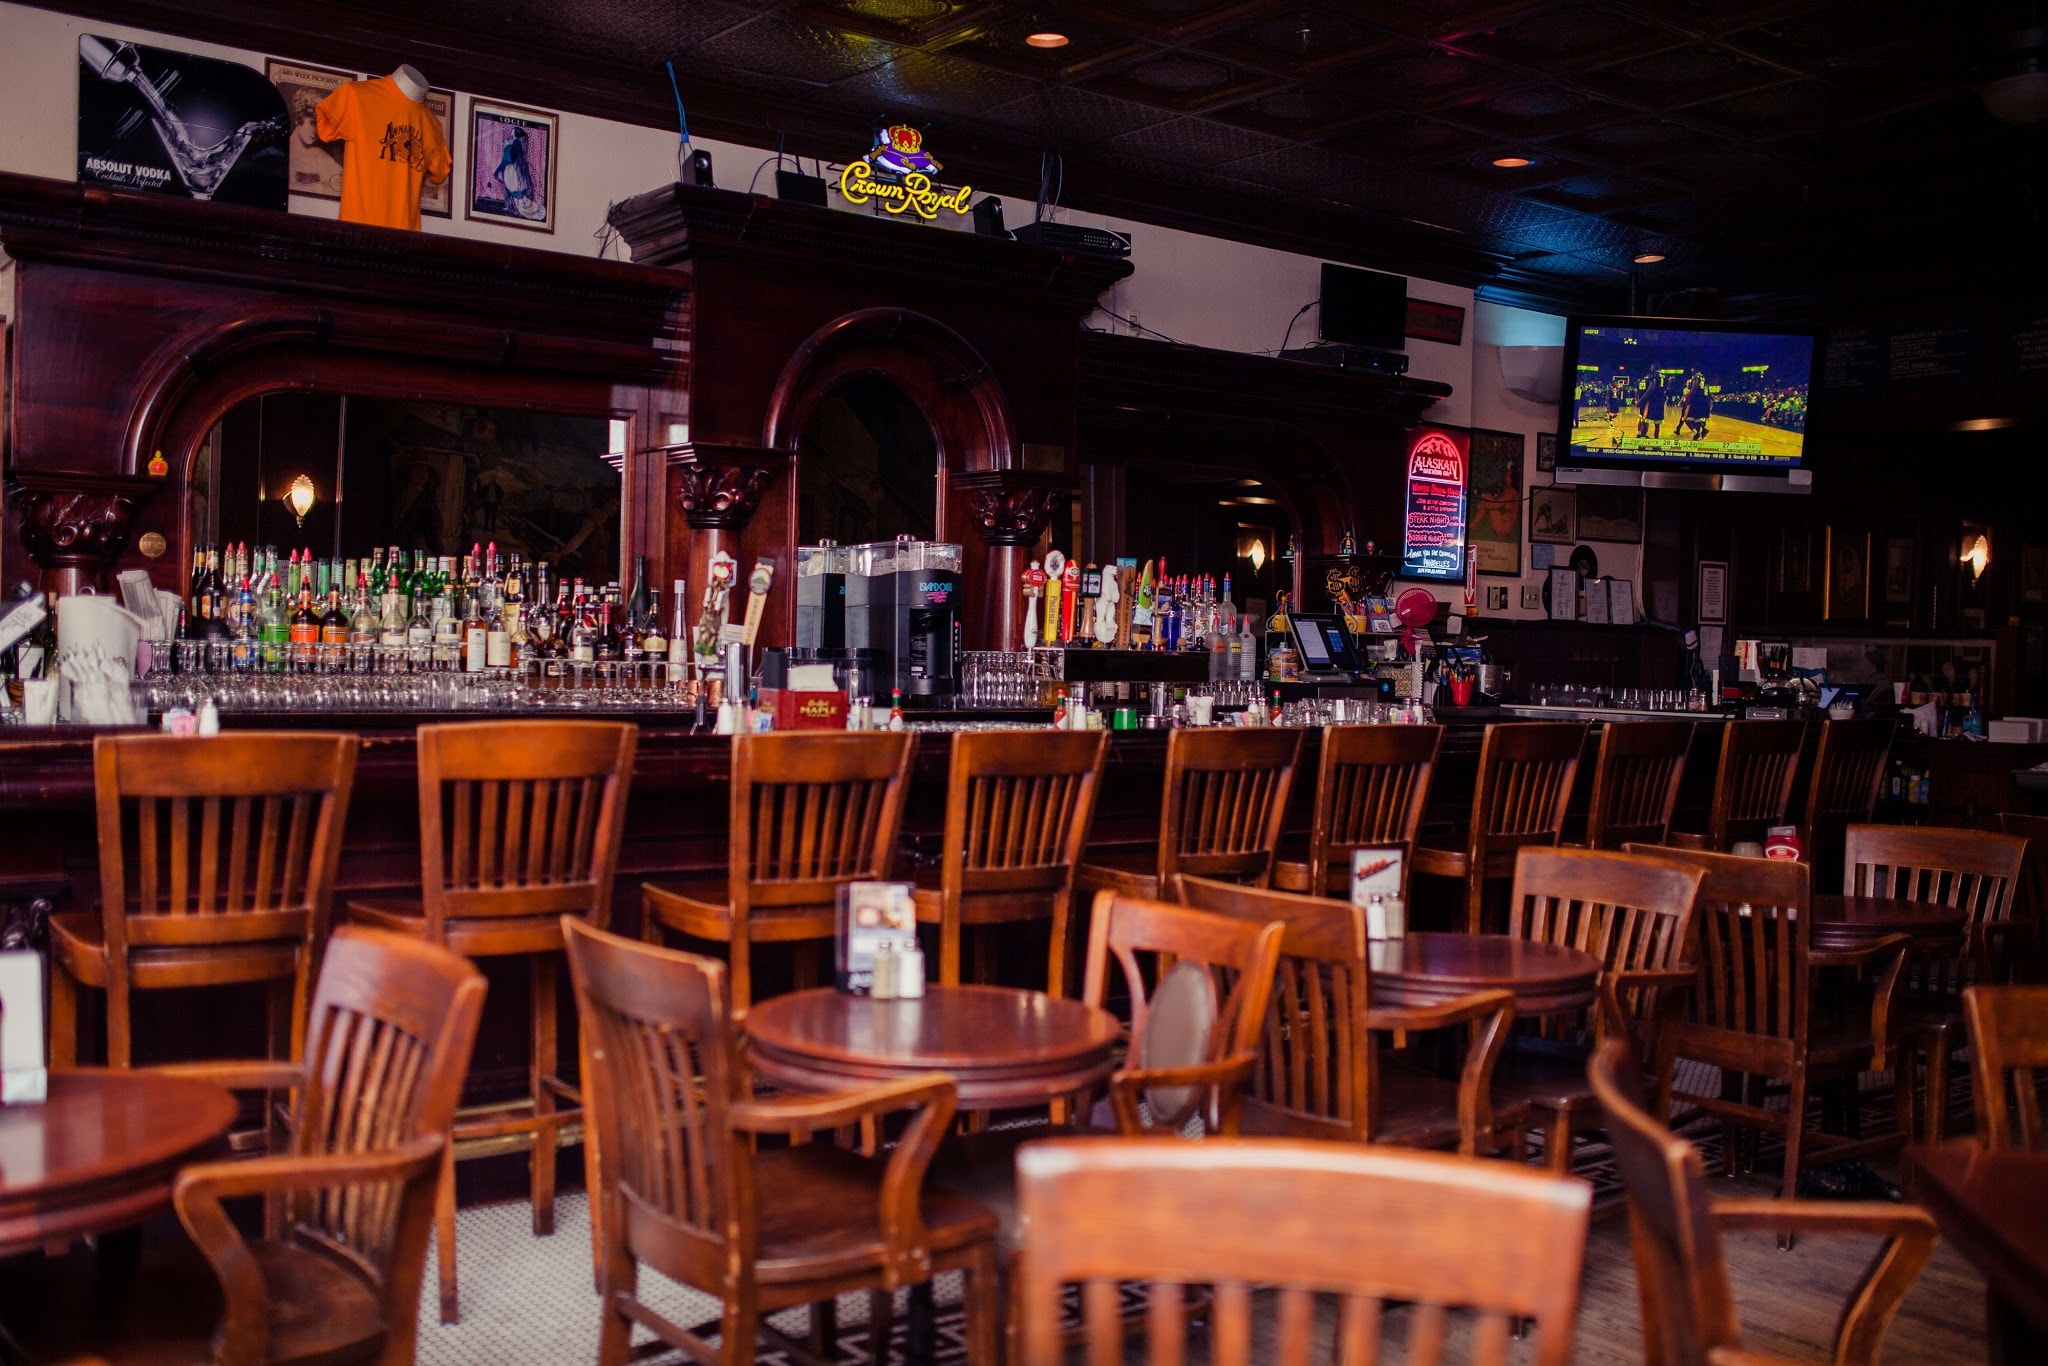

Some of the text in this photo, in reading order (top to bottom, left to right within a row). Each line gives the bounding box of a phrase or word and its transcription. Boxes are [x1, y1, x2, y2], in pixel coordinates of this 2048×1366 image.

[499, 117, 526, 127] VOGUE
[86, 158, 171, 181] ABSOLUT VODKA
[841, 161, 972, 220] Crown Royal
[1412, 456, 1459, 480] ALASKAN
[1409, 515, 1429, 524] STEAK
[1430, 516, 1448, 524] NIGHT
[1409, 532, 1427, 541] BURGER
[800, 706, 838, 715] MAPLE
